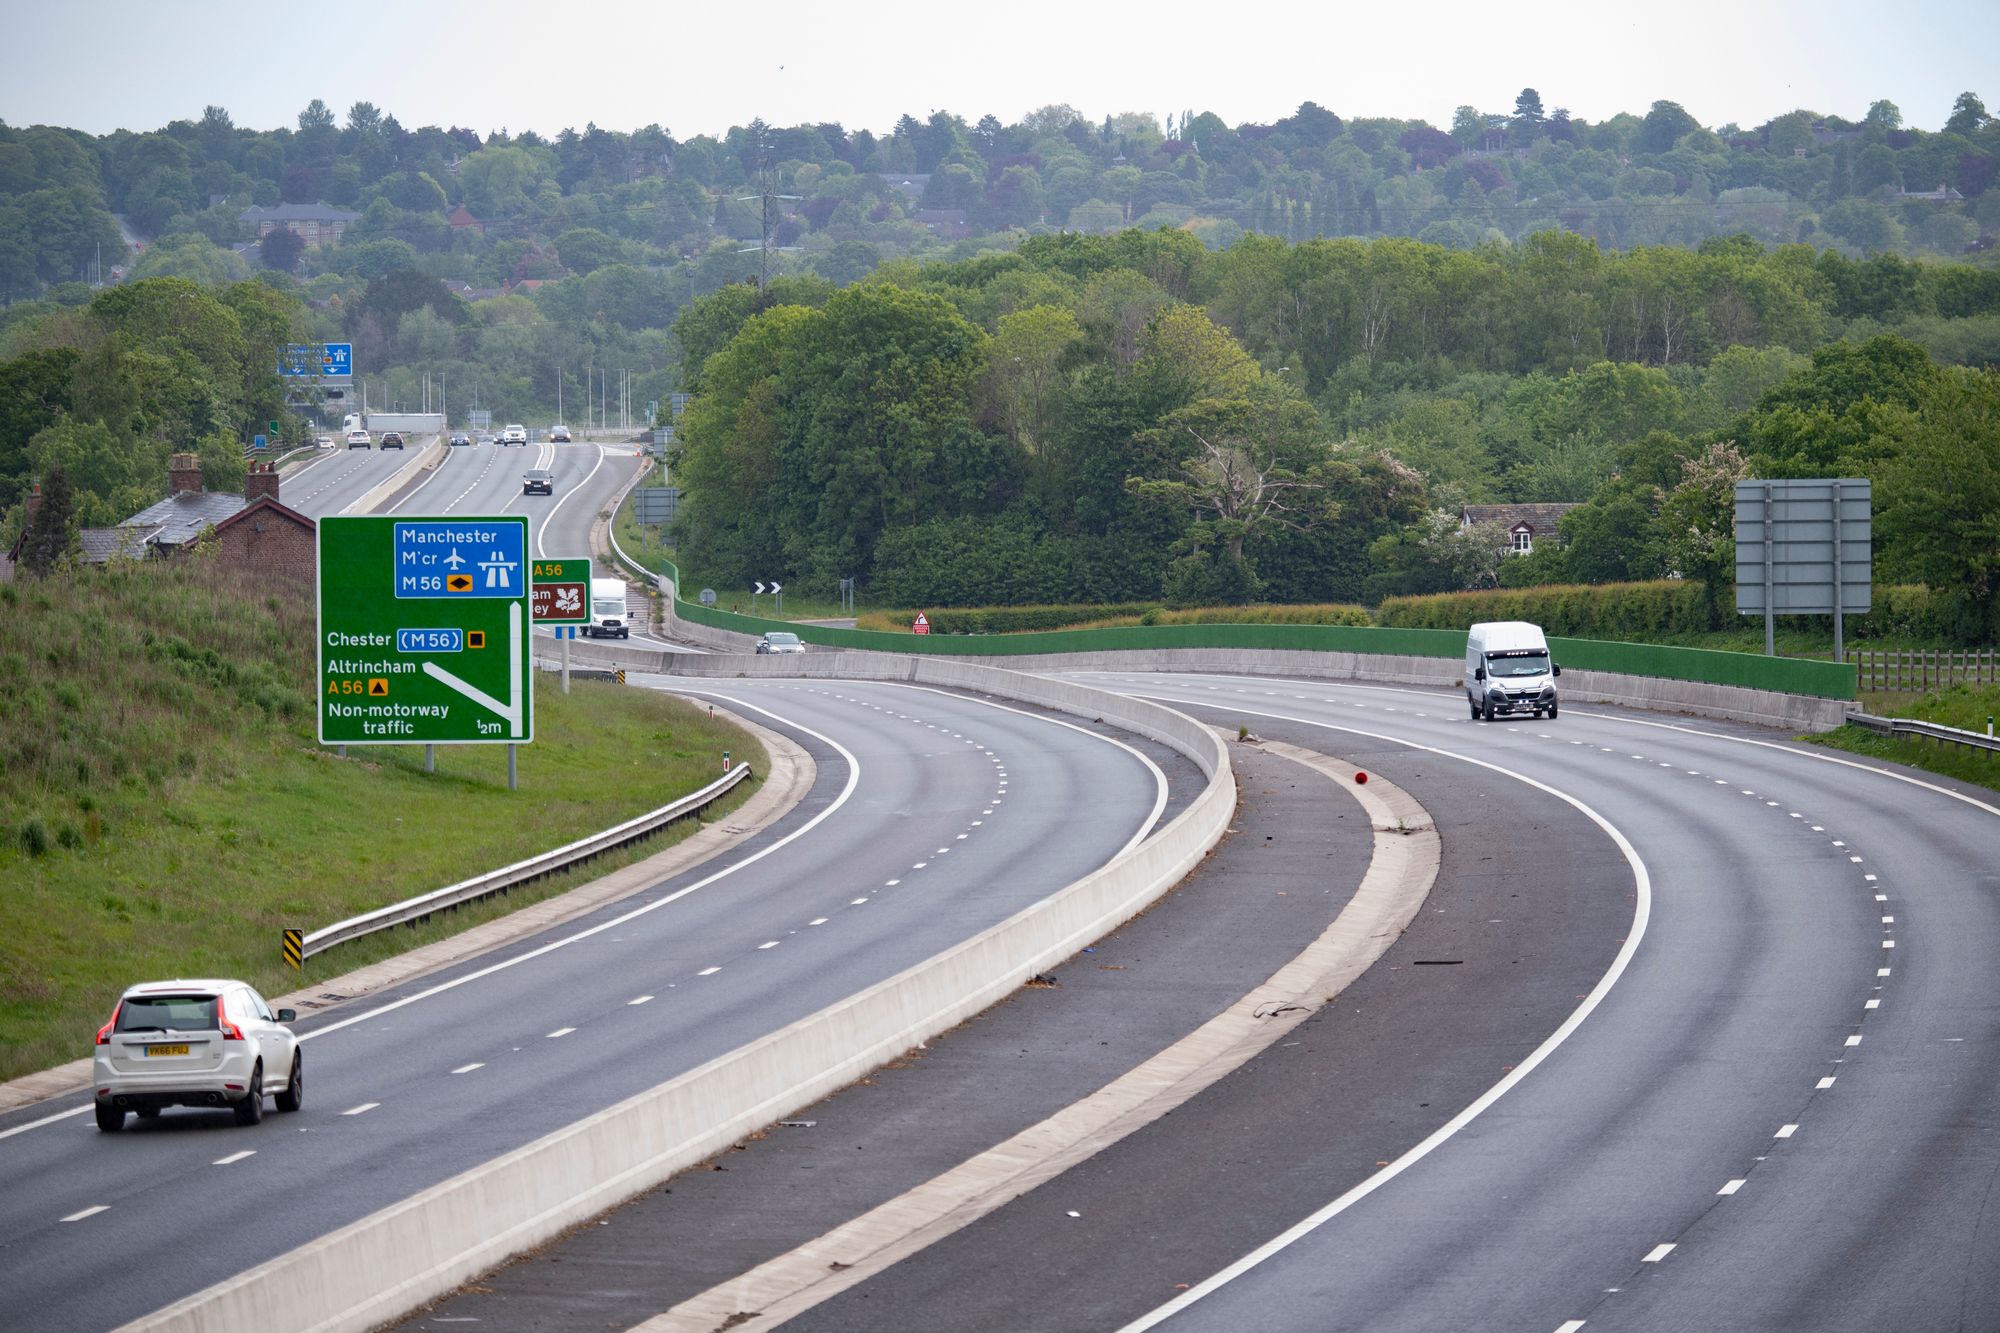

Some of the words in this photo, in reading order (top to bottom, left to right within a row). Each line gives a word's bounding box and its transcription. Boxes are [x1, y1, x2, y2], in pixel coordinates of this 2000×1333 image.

[402, 529, 497, 543] Manchester
[327, 632, 391, 646] Chester
[327, 660, 416, 673] Altrincham
[328, 703, 449, 719] Non-motorway
[363, 721, 414, 734] traffic
